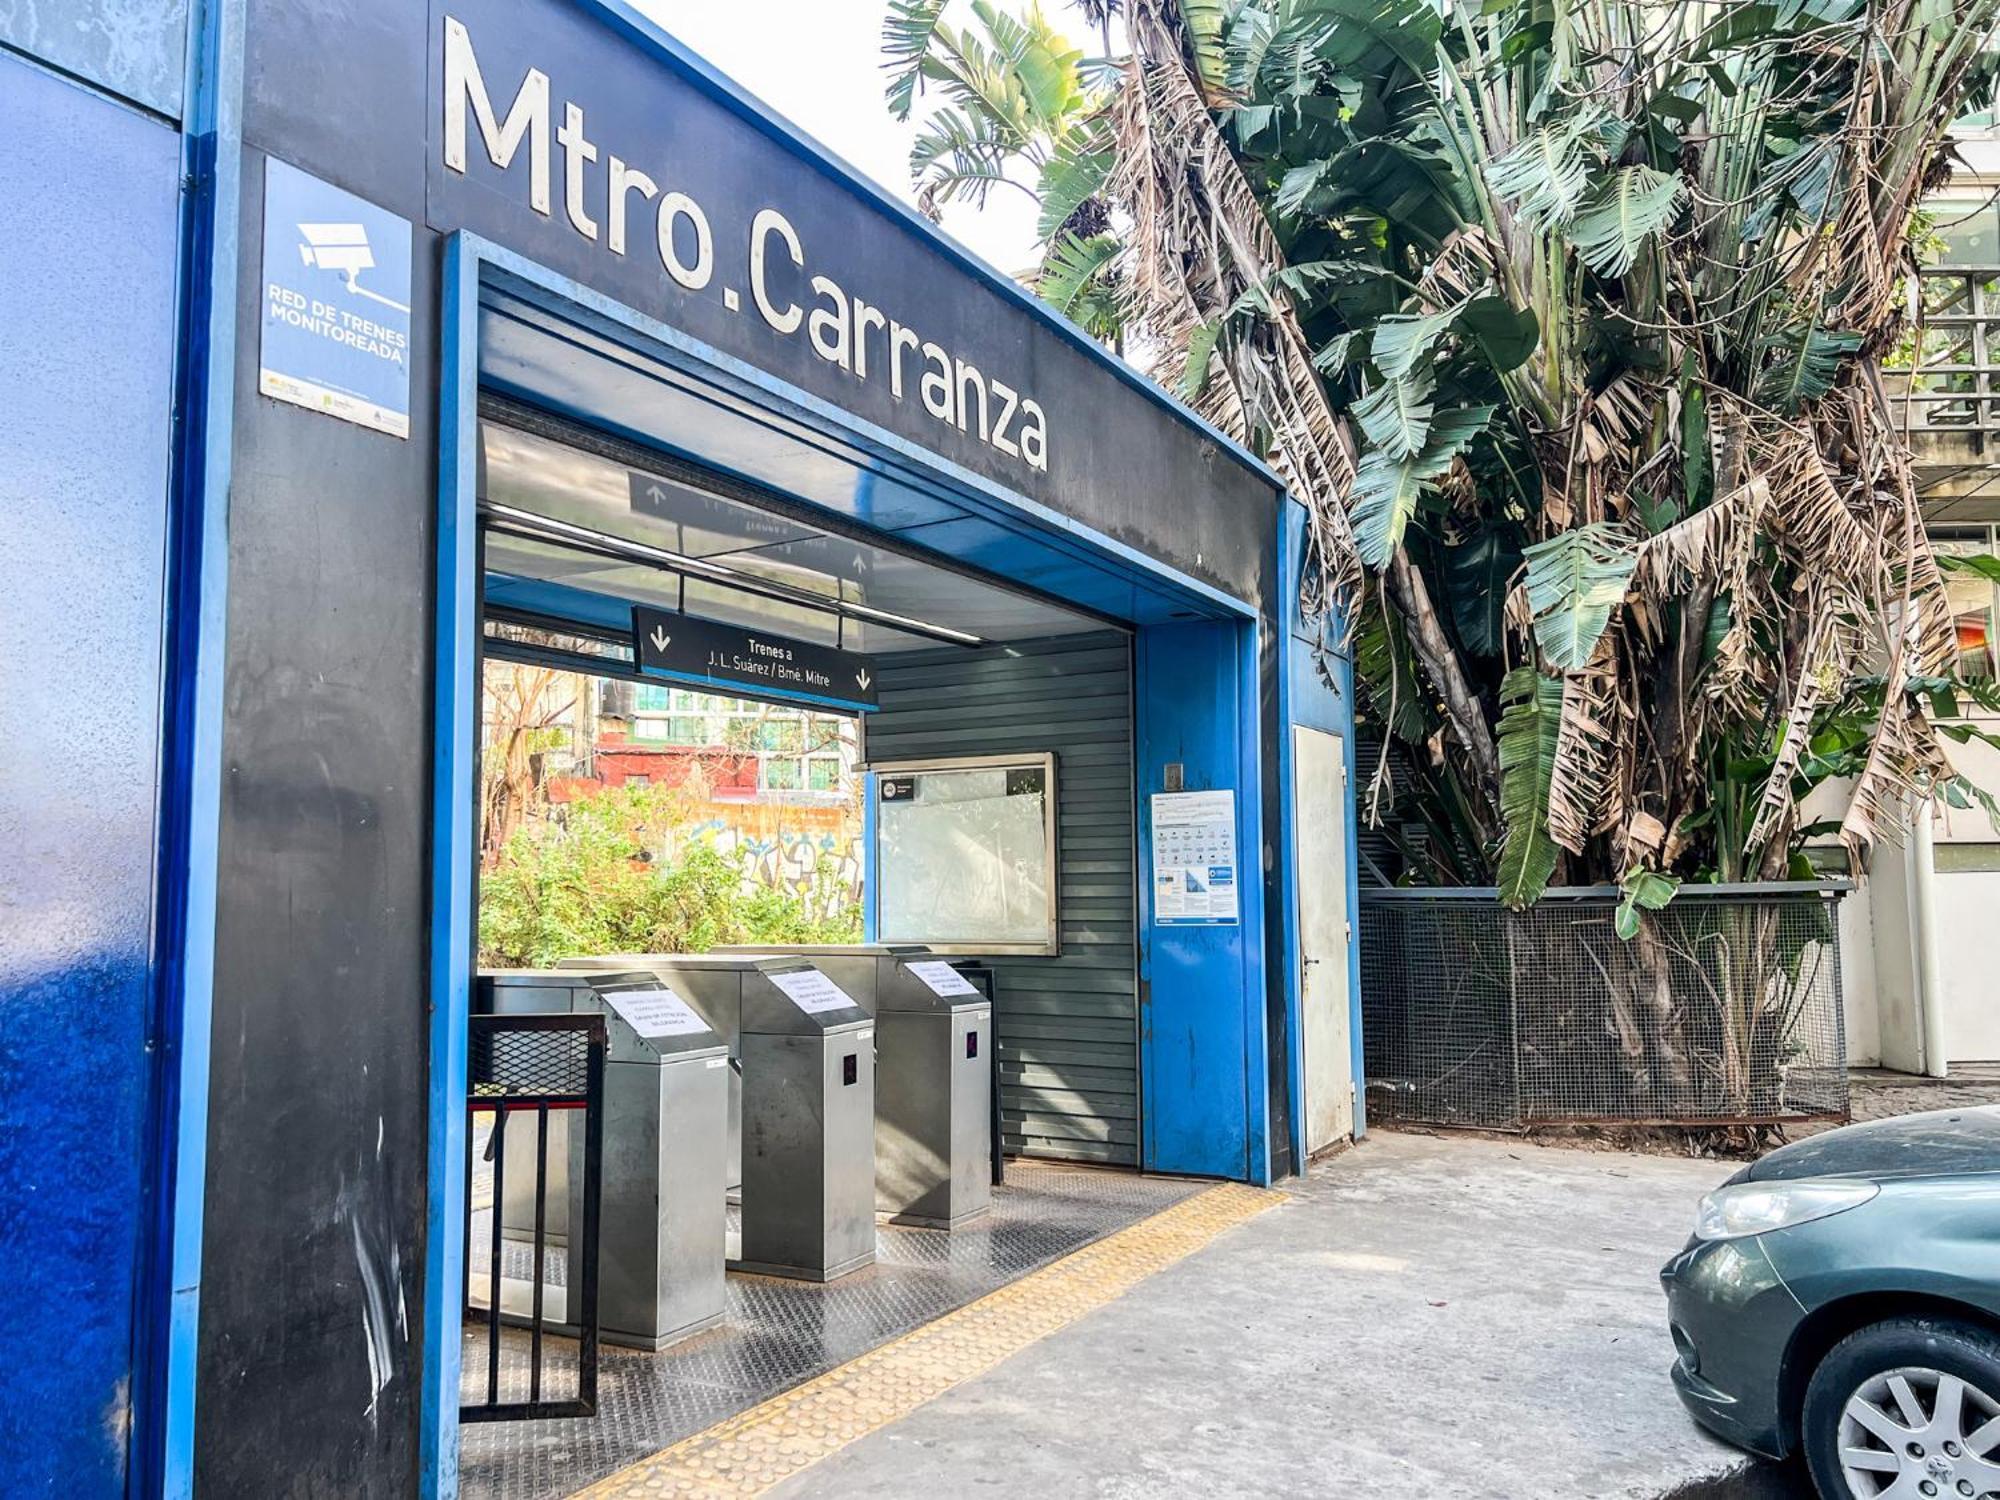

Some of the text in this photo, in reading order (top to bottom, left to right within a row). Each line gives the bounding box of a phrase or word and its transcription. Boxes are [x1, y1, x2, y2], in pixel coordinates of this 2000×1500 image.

[269, 284, 406, 349] RED DE TRENES
[271, 302, 404, 364] MONITOREADA
[708, 650, 718, 666] J.
[720, 652, 731, 669] L.
[733, 655, 769, 676] Suárez
[806, 669, 830, 688] Mitre
[748, 638, 793, 661] Trenes a
